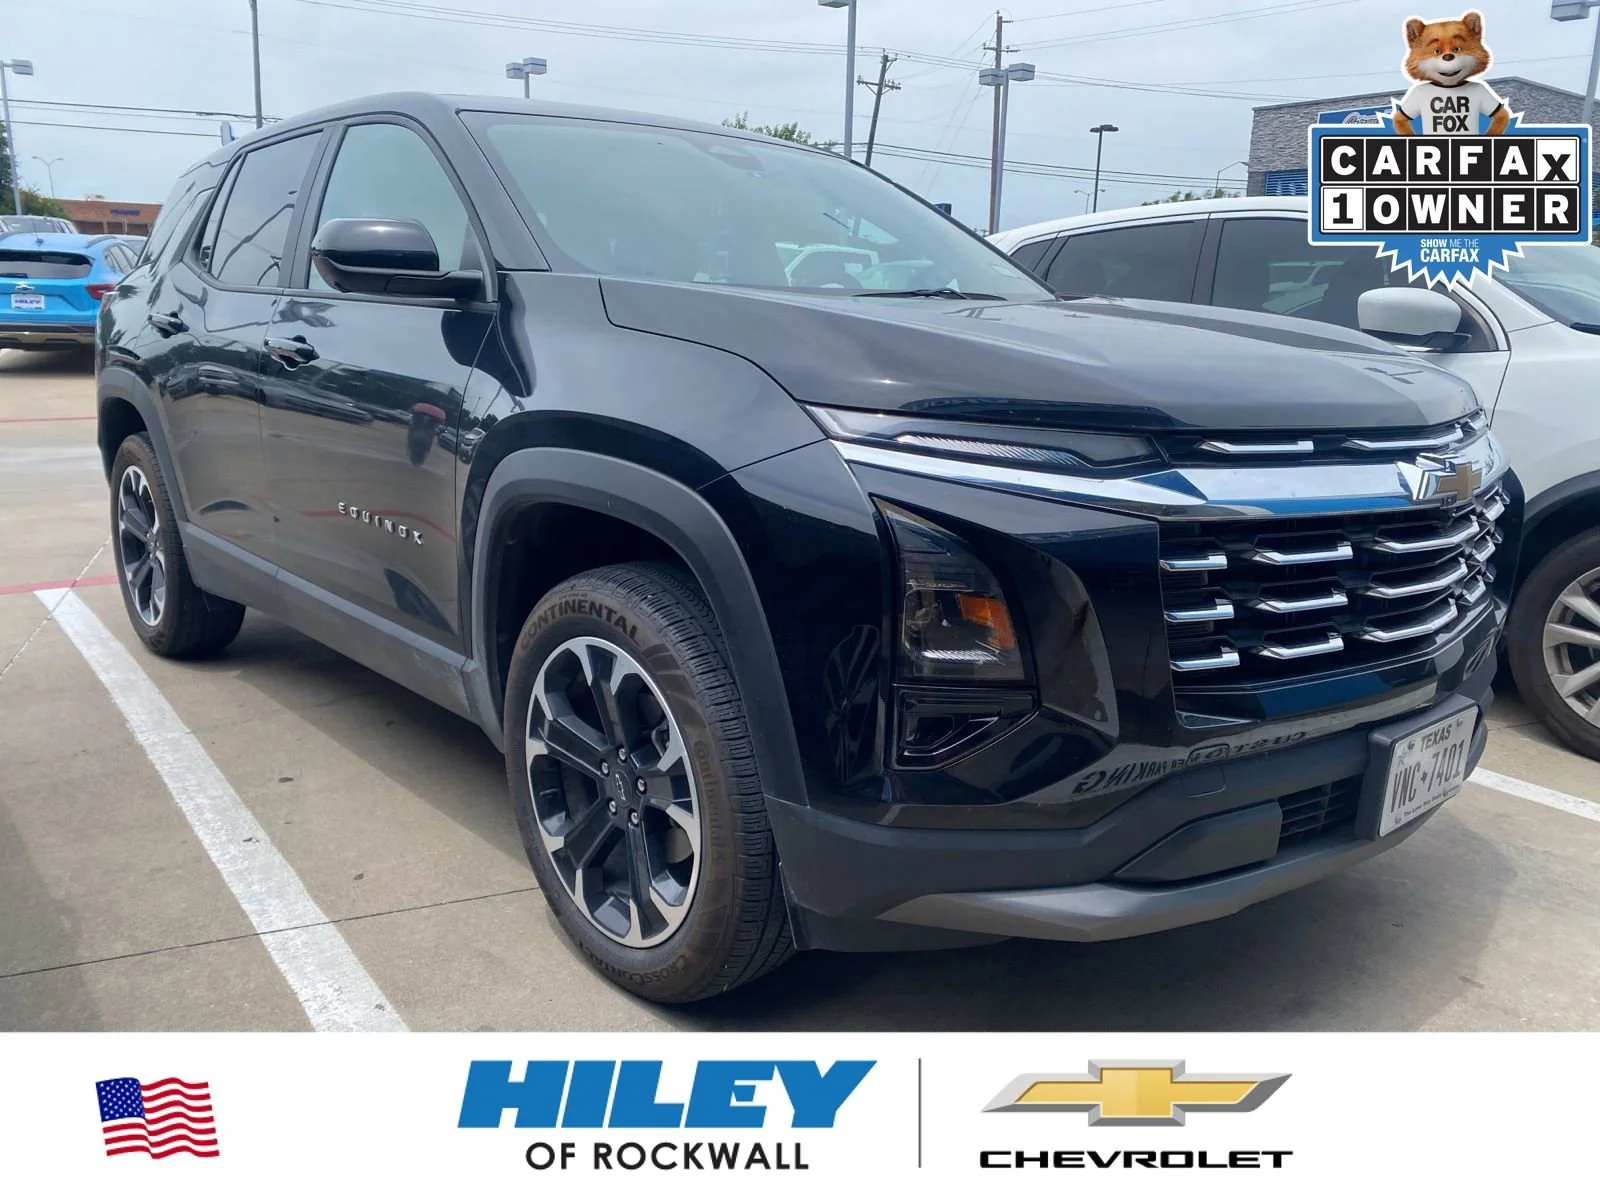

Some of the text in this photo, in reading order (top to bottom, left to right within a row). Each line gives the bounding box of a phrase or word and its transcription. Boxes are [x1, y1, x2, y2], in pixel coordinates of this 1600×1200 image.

[338, 502, 424, 545] EQUINOX
[519, 598, 642, 649] CONTINENTAL
[1420, 724, 1452, 752] TEXAS
